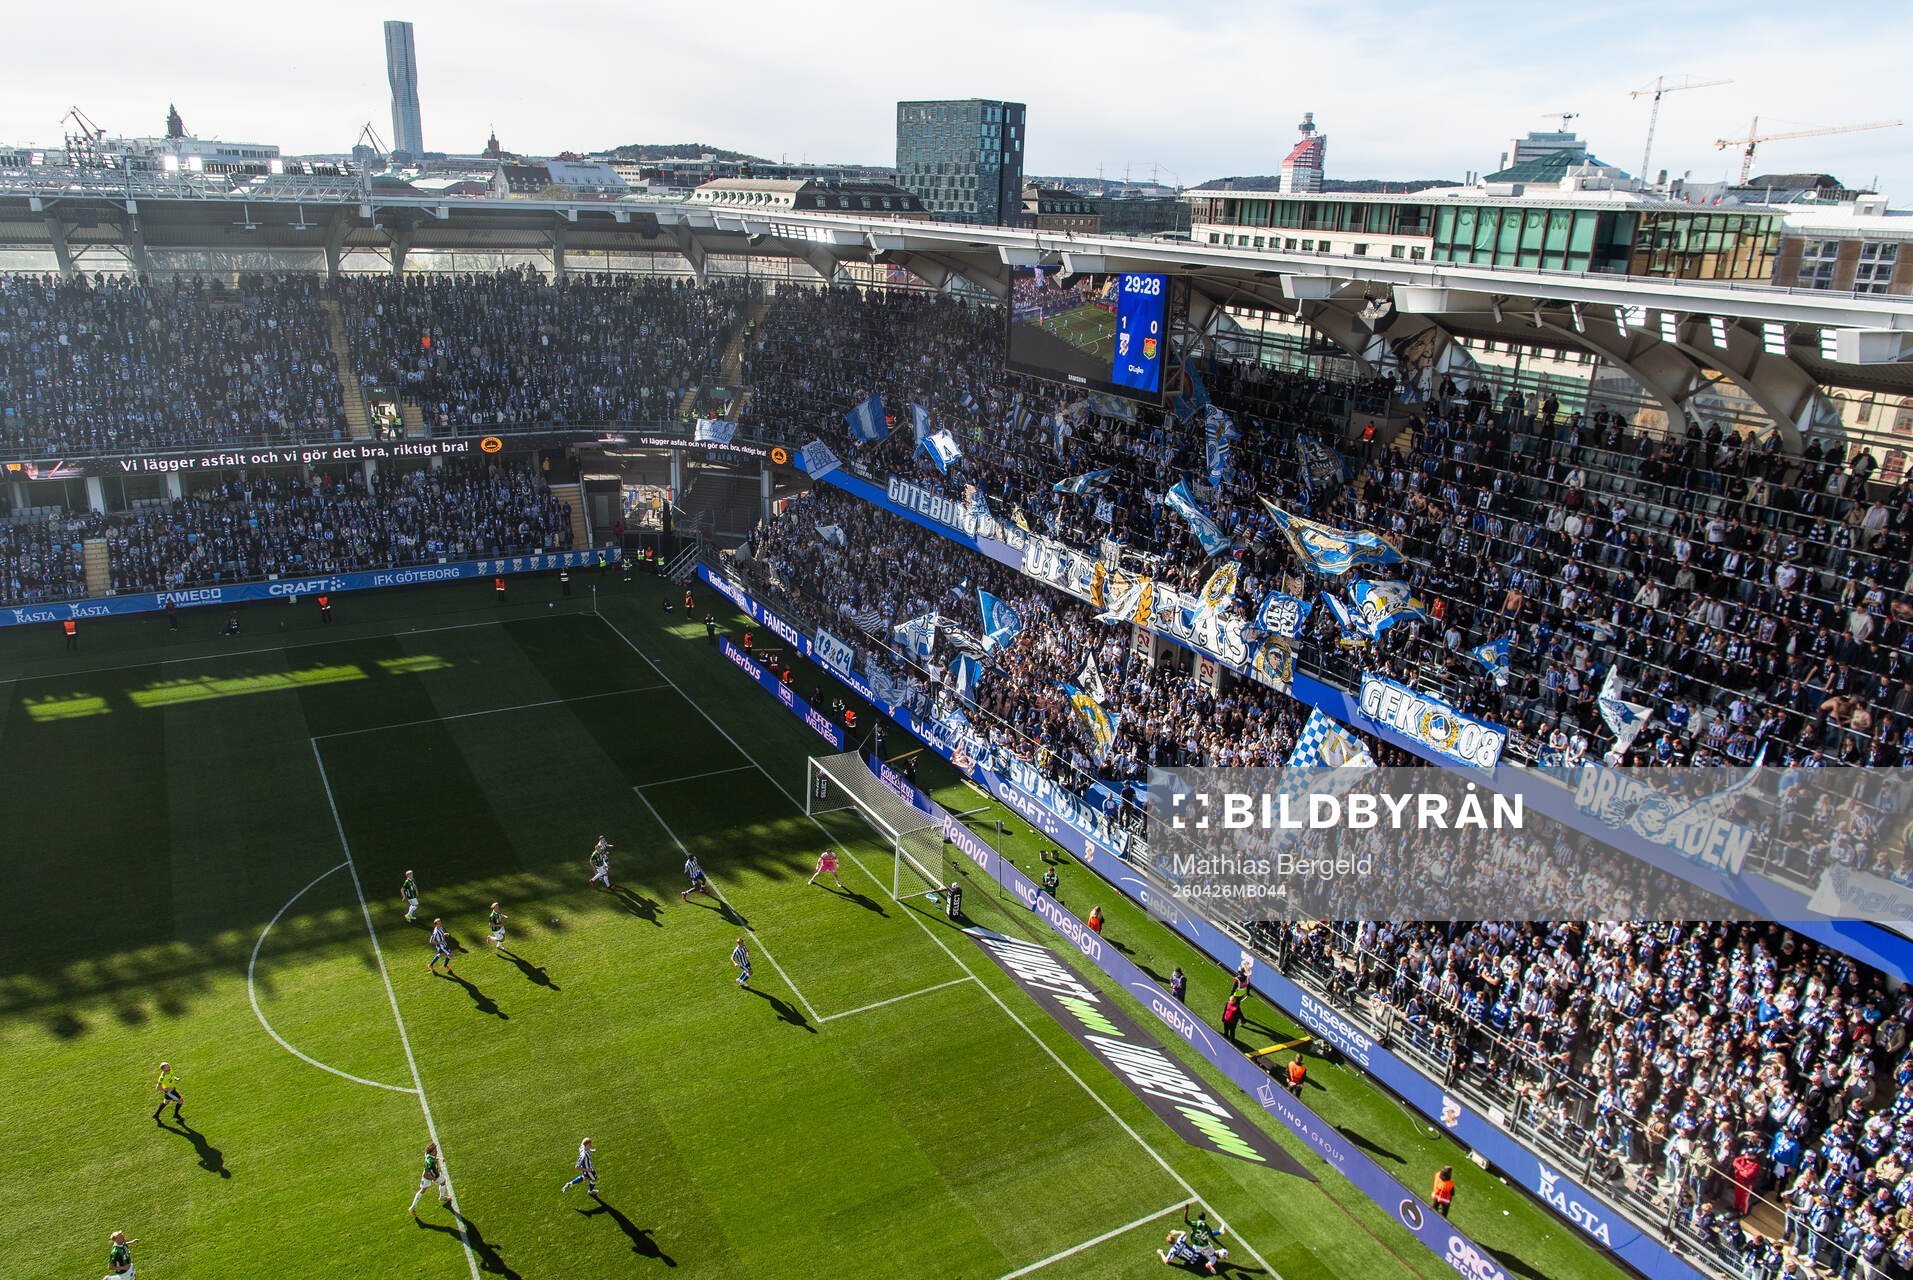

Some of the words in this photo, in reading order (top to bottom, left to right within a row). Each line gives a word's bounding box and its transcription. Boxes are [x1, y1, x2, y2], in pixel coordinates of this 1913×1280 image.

[1125, 275, 1160, 296] 29:28
[1122, 316, 1127, 329] 1
[1151, 321, 1158, 334] 0
[1068, 374, 1087, 384] SAMSUNG
[121, 459, 138, 472] Vi
[143, 457, 196, 473] lägger
[201, 453, 247, 468] asfalt
[251, 451, 279, 464] och
[284, 449, 297, 462] vi
[302, 447, 328, 463] gör
[333, 447, 357, 460] det
[361, 445, 389, 458] bra,
[393, 442, 438, 456] riktigt
[442, 440, 470, 453] bra!
[649, 437, 669, 446] lägger
[671, 438, 687, 447] asfalt
[688, 439, 699, 448] och
[707, 442, 718, 450] gör
[269, 579, 329, 595] CRAFT
[374, 574, 394, 585] IFK
[396, 568, 460, 583] GÖTEBORG
[72, 606, 111, 618] RASTA
[157, 588, 222, 605] FAMECO
[16, 611, 57, 624] RASTA
[763, 610, 798, 647] FAMECO
[725, 642, 761, 680] Interbus
[805, 713, 838, 747] WELLNESS
[810, 707, 833, 733] NORDIC
[1361, 680, 1425, 737] GFK
[1459, 723, 1500, 768] 08
[999, 783, 1046, 824] CRAFT
[943, 815, 989, 868] Renova
[1140, 890, 1179, 924] cuebid
[1152, 998, 1194, 1040] cuebid
[1301, 995, 1373, 1052] sunseeker
[1299, 1008, 1370, 1067] ROBOTICS
[1277, 1102, 1309, 1134] VINGA
[1311, 1131, 1345, 1162] GROUP
[1538, 1178, 1612, 1246] RASTA
[1195, 1229, 1208, 1241] 26
[1181, 1247, 1195, 1261] 18
